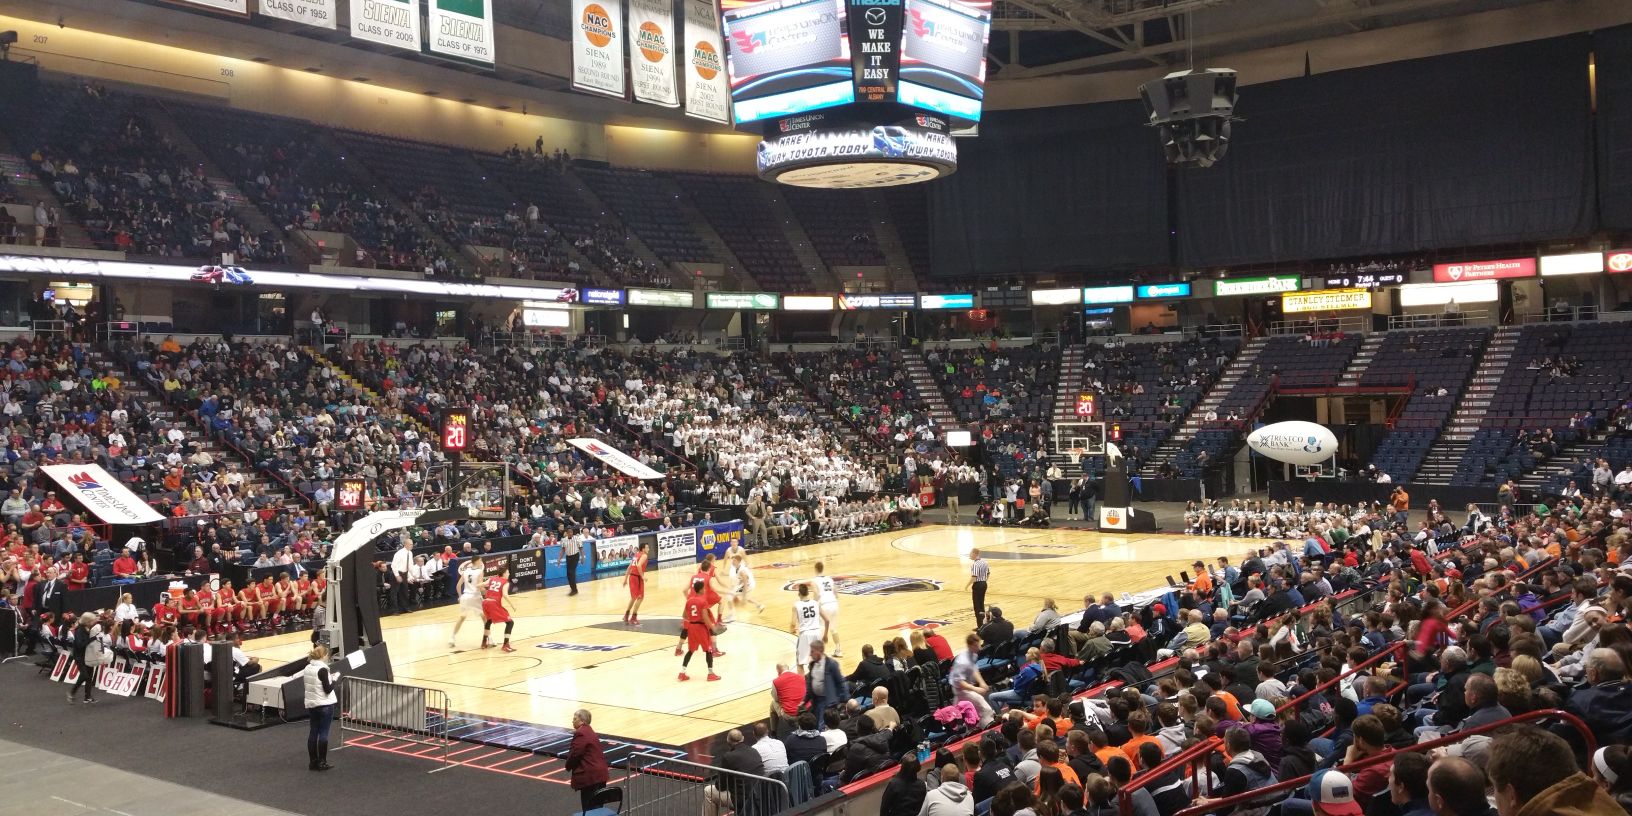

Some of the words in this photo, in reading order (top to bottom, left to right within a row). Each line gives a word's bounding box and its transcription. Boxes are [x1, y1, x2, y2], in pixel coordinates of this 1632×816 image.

[266, 0, 294, 12] CLASS
[296, 6, 307, 14] OF
[310, 8, 328, 20] 1952
[363, 0, 411, 28] SIENA
[588, 13, 608, 28] NAC
[358, 22, 382, 35] CLASS
[384, 28, 394, 38] OF
[396, 31, 414, 42] 2009
[440, 14, 484, 42] SIENA
[581, 24, 616, 38] CHAMPIONS
[33, 35, 48, 44] 207
[640, 30, 665, 45] MAAC
[868, 29, 884, 40] WE
[438, 38, 460, 50] CLASS
[462, 44, 472, 52] OF
[474, 46, 488, 56] 1973
[636, 40, 668, 54] CHAMPIONS
[862, 42, 890, 52] MAKE
[586, 48, 610, 60] SIENA
[694, 48, 718, 63] MAAC
[692, 59, 721, 72] CHAMPIONS
[871, 55, 882, 66] IT
[220, 68, 234, 78] 208
[641, 64, 664, 76] SIENA
[864, 68, 889, 79] EASY
[696, 82, 717, 94] SIENA
[700, 92, 714, 102] 2002
[780, 136, 801, 146] MAKE
[927, 134, 945, 144] MAKE
[790, 147, 827, 160] TOYOTA
[834, 145, 869, 154] TODAY
[1288, 295, 1324, 305] STANLEY
[1326, 293, 1365, 303] STEEMER
[1078, 402, 1092, 414] 20
[448, 427, 464, 446] 20
[1270, 434, 1304, 442] TRUSTCO
[344, 492, 356, 505] 20
[704, 535, 714, 544] NAPA
[515, 570, 538, 578] DESIGNATE
[489, 580, 501, 592] 22
[690, 605, 698, 616] 2
[803, 606, 816, 618] 25
